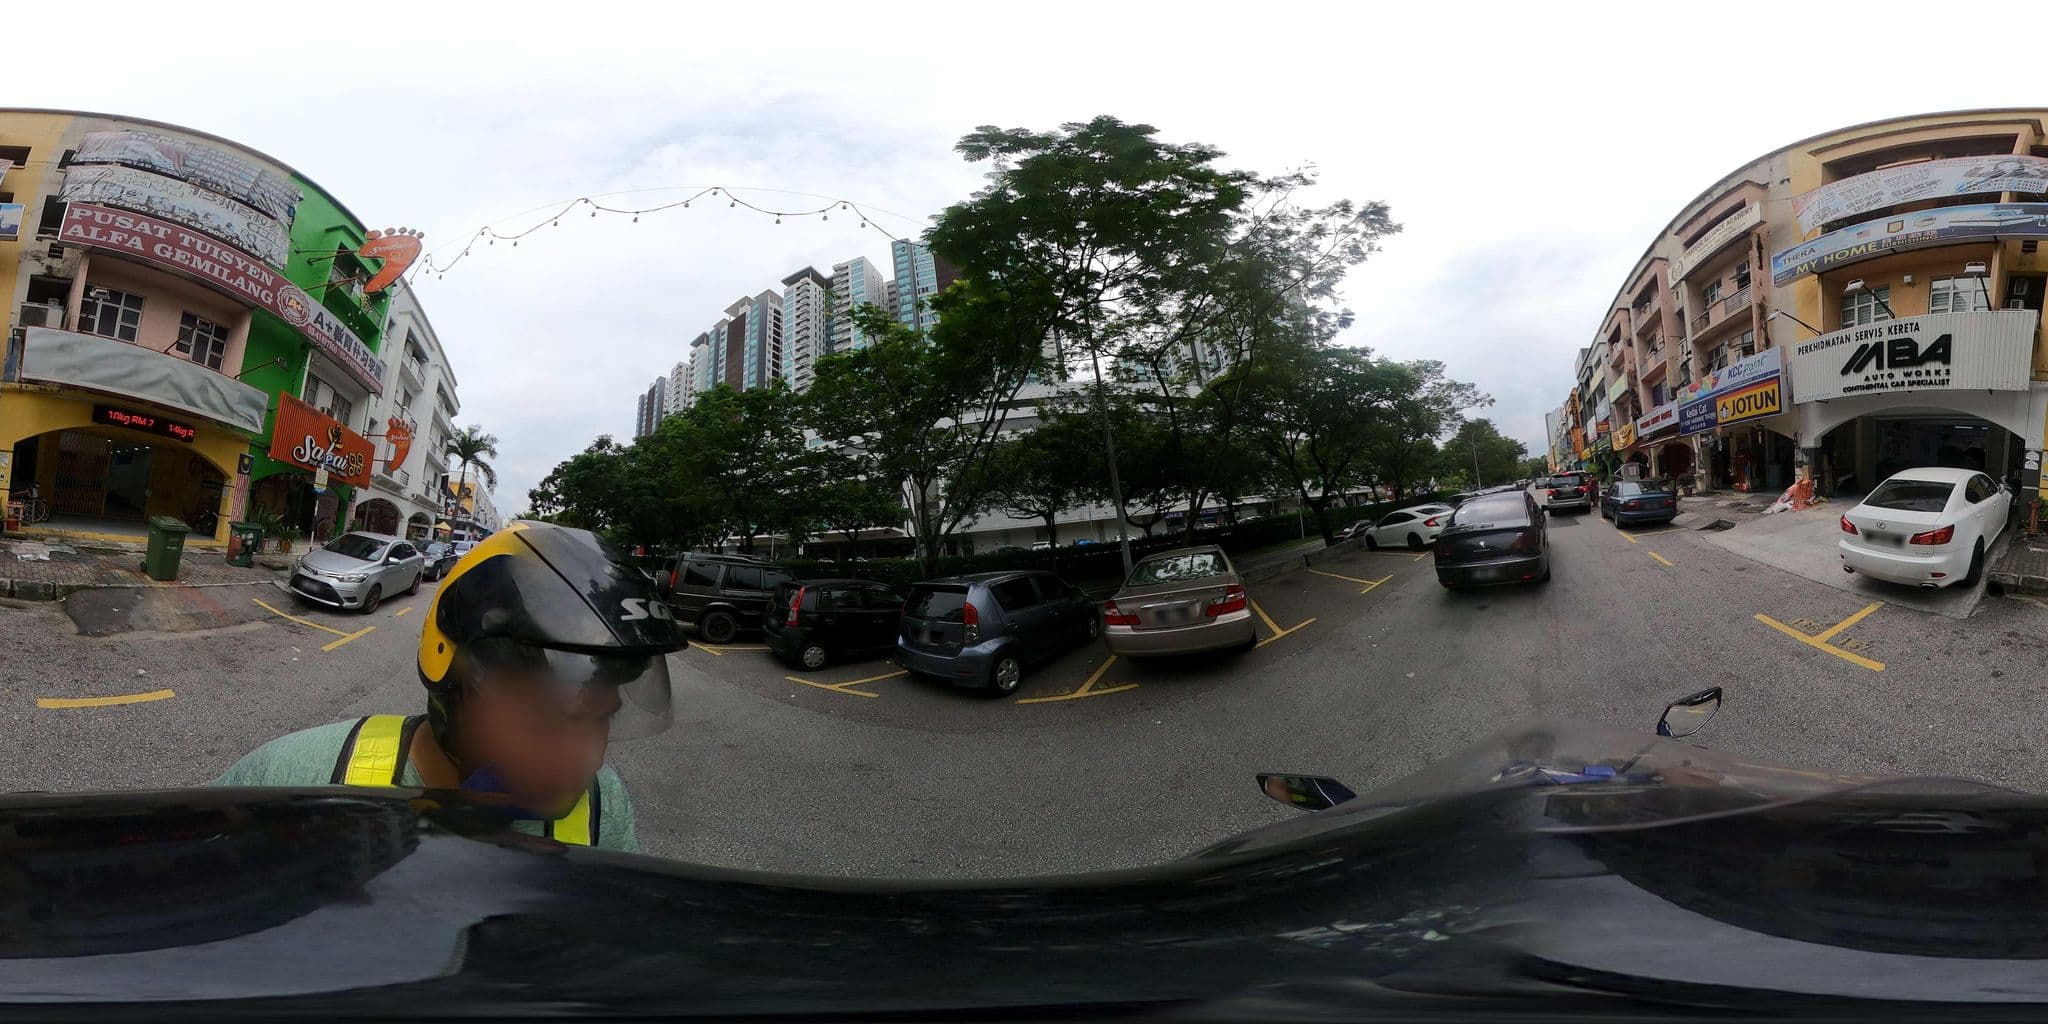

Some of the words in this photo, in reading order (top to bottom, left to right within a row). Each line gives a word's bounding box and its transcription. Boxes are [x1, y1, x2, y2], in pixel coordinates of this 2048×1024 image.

[1726, 206, 1754, 227] ACADEMY
[70, 207, 172, 239] PUSAT
[179, 231, 274, 287] TUISYEN
[1782, 245, 1817, 266] THERA
[1796, 258, 1818, 276] MY
[1824, 242, 1879, 265] HOME
[64, 224, 144, 251] ALFA
[153, 244, 274, 306] GEMILANG
[1798, 333, 1852, 356] PERKHIDMATAN
[1854, 328, 1883, 342] SERVIS
[1887, 322, 1920, 336] KERETA
[1840, 334, 1952, 376] MBA
[1727, 364, 1744, 380] KCC
[1842, 382, 1890, 394] CONTINENTAL
[1890, 380, 1906, 388] CAR
[1907, 378, 1951, 388] SPECIALIST
[1864, 372, 1895, 382] AUTO
[1902, 368, 1952, 378] WORKS
[1730, 388, 1777, 417] JOTUN
[108, 410, 130, 424] 10kg
[132, 416, 146, 426] RM
[148, 419, 155, 427] 7
[168, 424, 187, 438] 14kg
[326, 455, 334, 464] P
